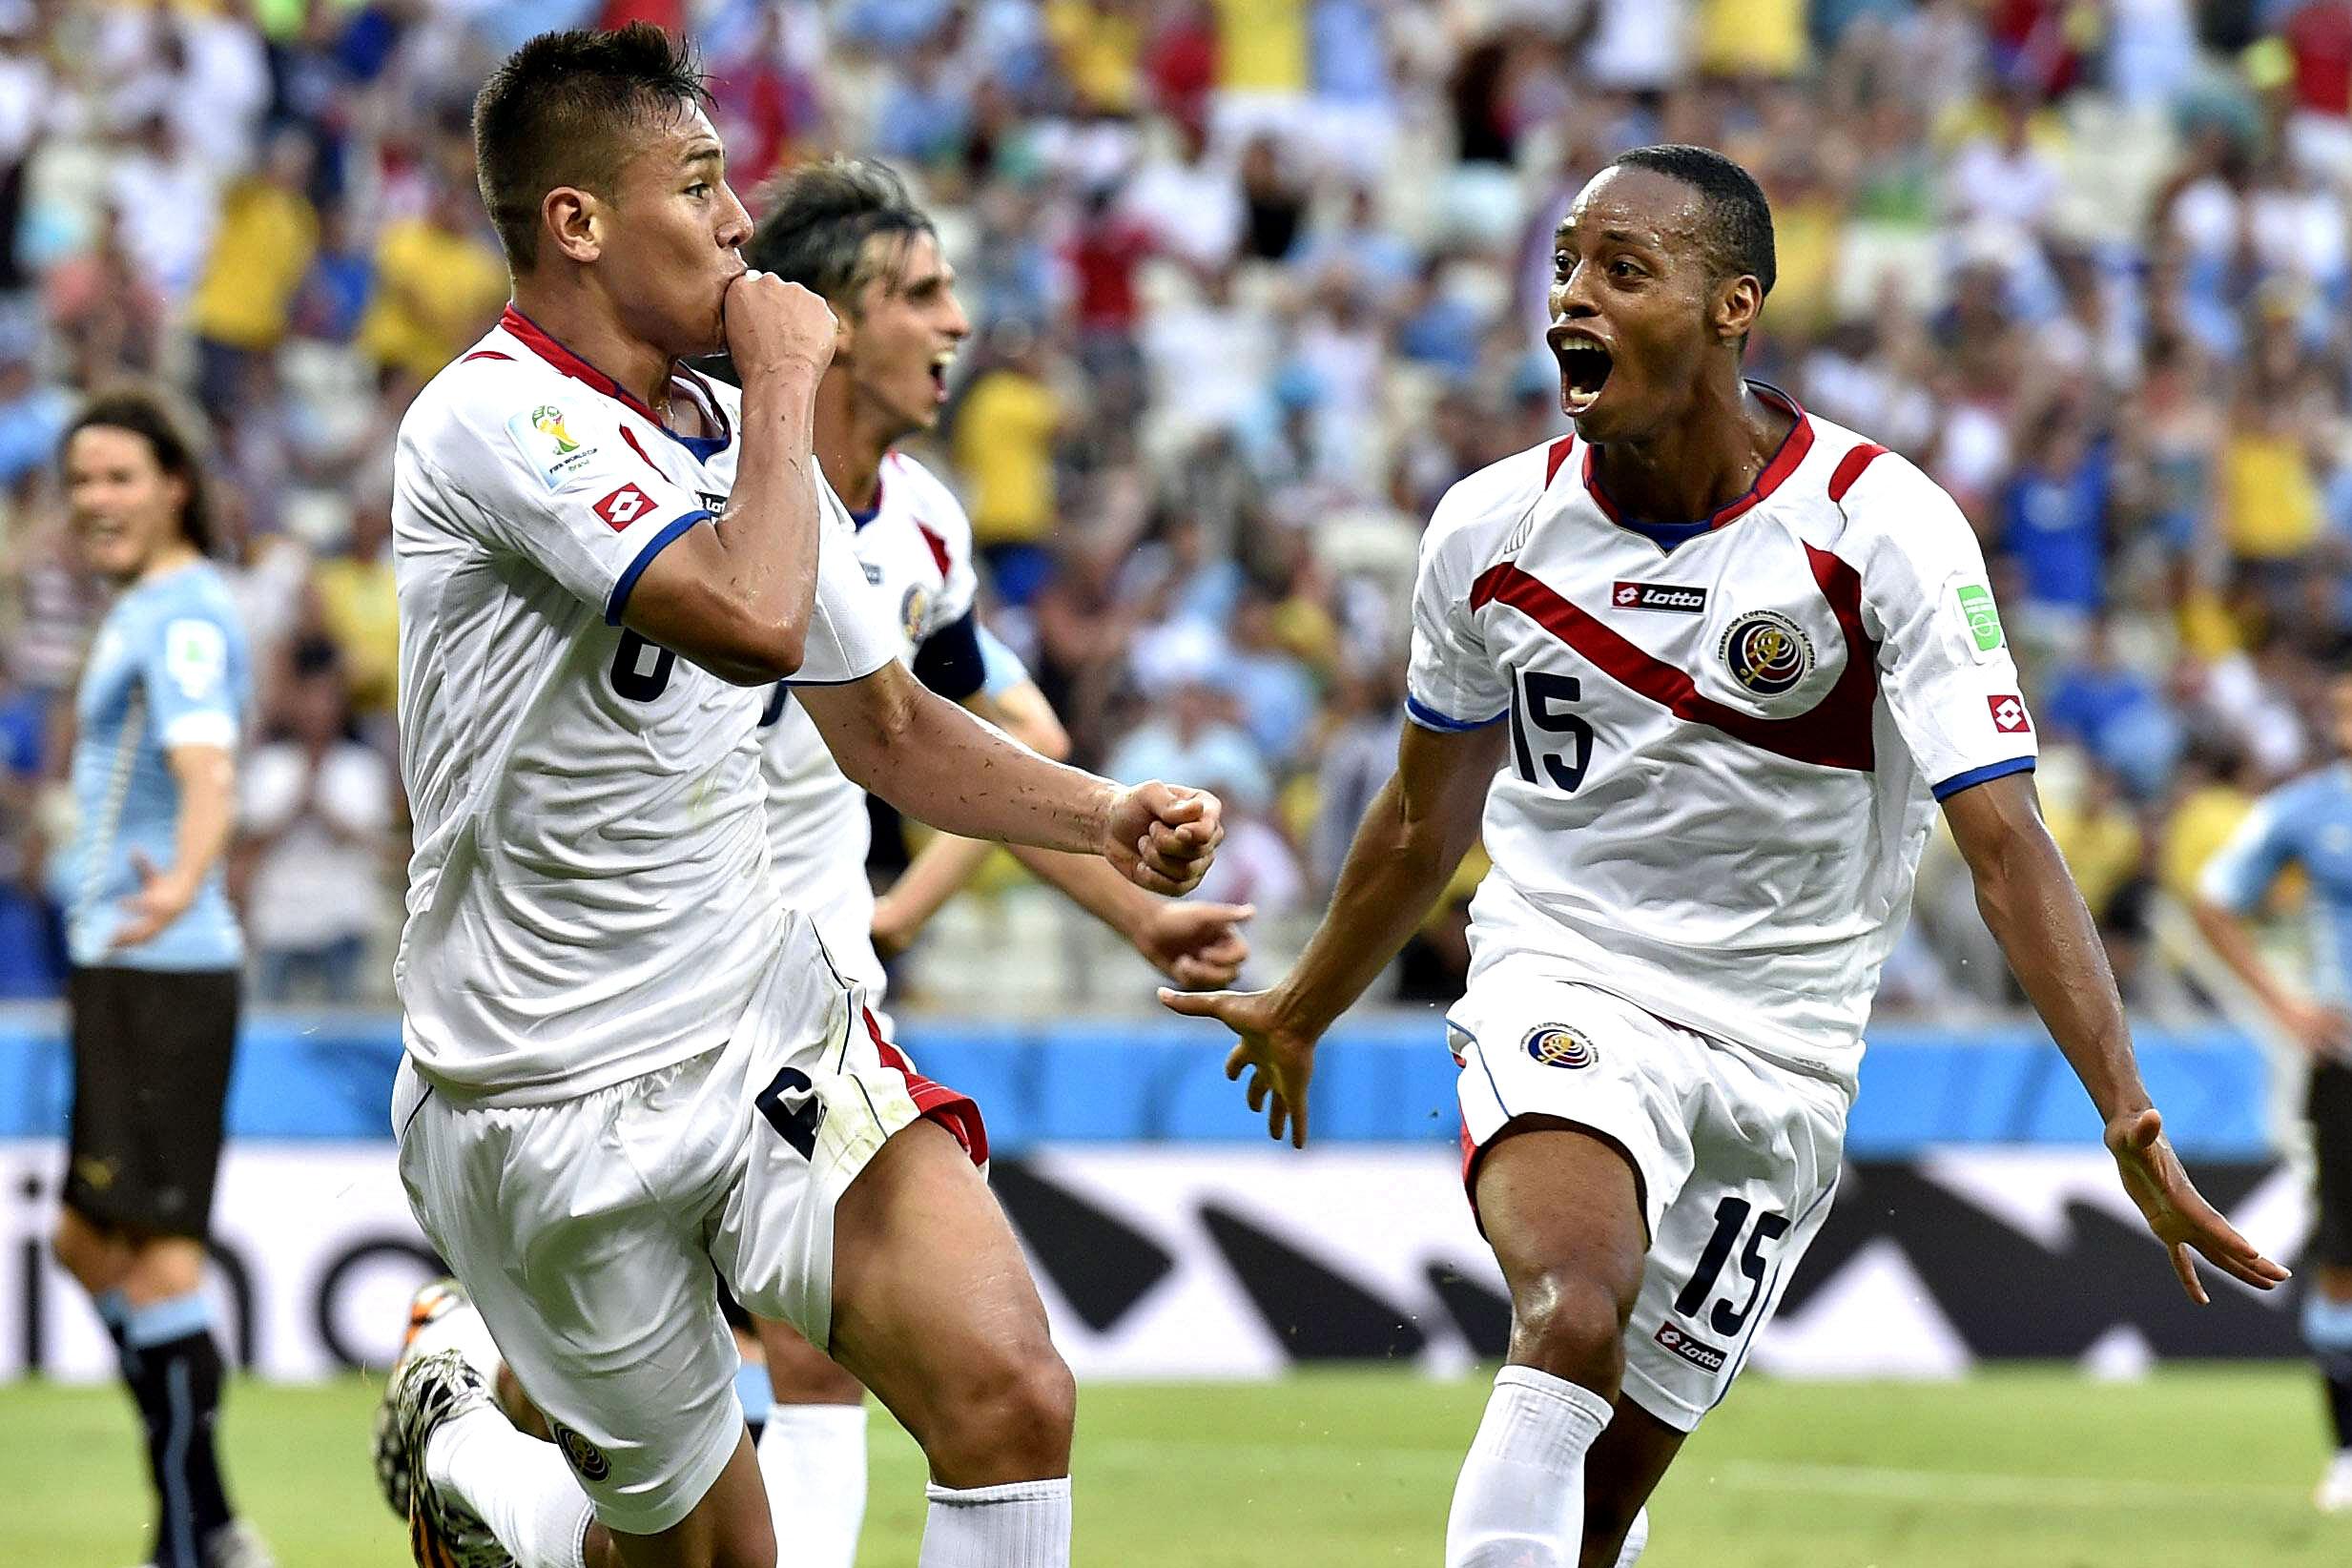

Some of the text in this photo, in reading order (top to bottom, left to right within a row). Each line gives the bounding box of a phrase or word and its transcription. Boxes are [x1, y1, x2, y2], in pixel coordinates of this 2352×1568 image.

[1641, 588, 1704, 608] Lotto
[1509, 661, 1594, 794] 15
[1674, 1196, 1792, 1337] 15
[1678, 1341, 1723, 1369] Lotto
